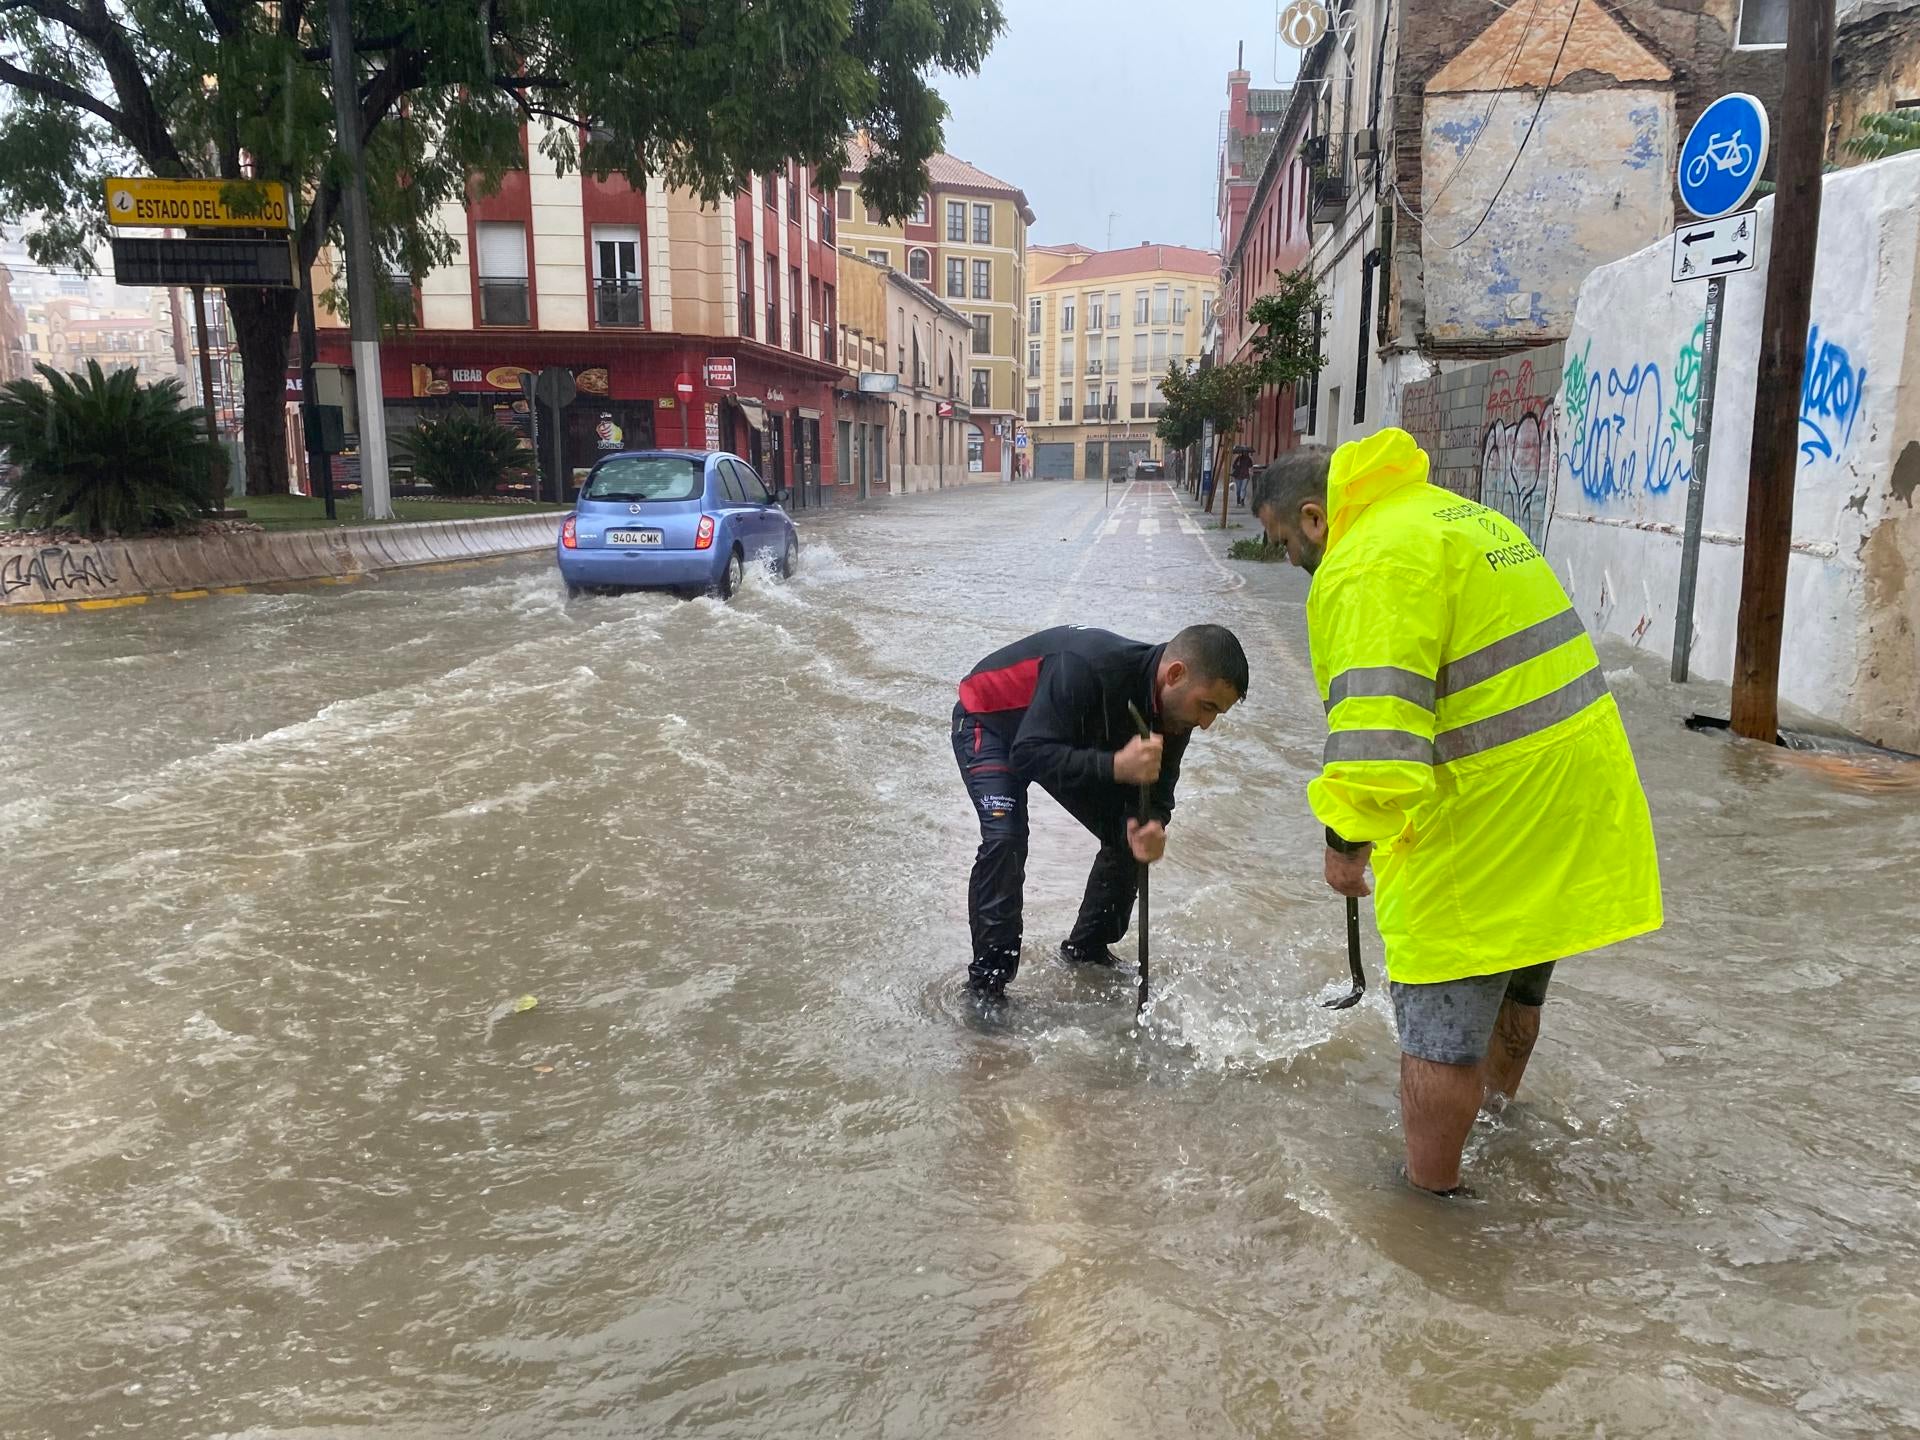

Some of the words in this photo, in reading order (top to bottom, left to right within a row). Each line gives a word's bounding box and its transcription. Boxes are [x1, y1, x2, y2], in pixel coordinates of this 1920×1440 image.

[135, 198, 190, 219] ESTADO
[193, 200, 221, 219] DEL
[708, 364, 733, 372] KEBAB
[452, 369, 482, 382] KEBAB
[612, 533, 637, 543] 9404
[640, 533, 659, 543] CMK
